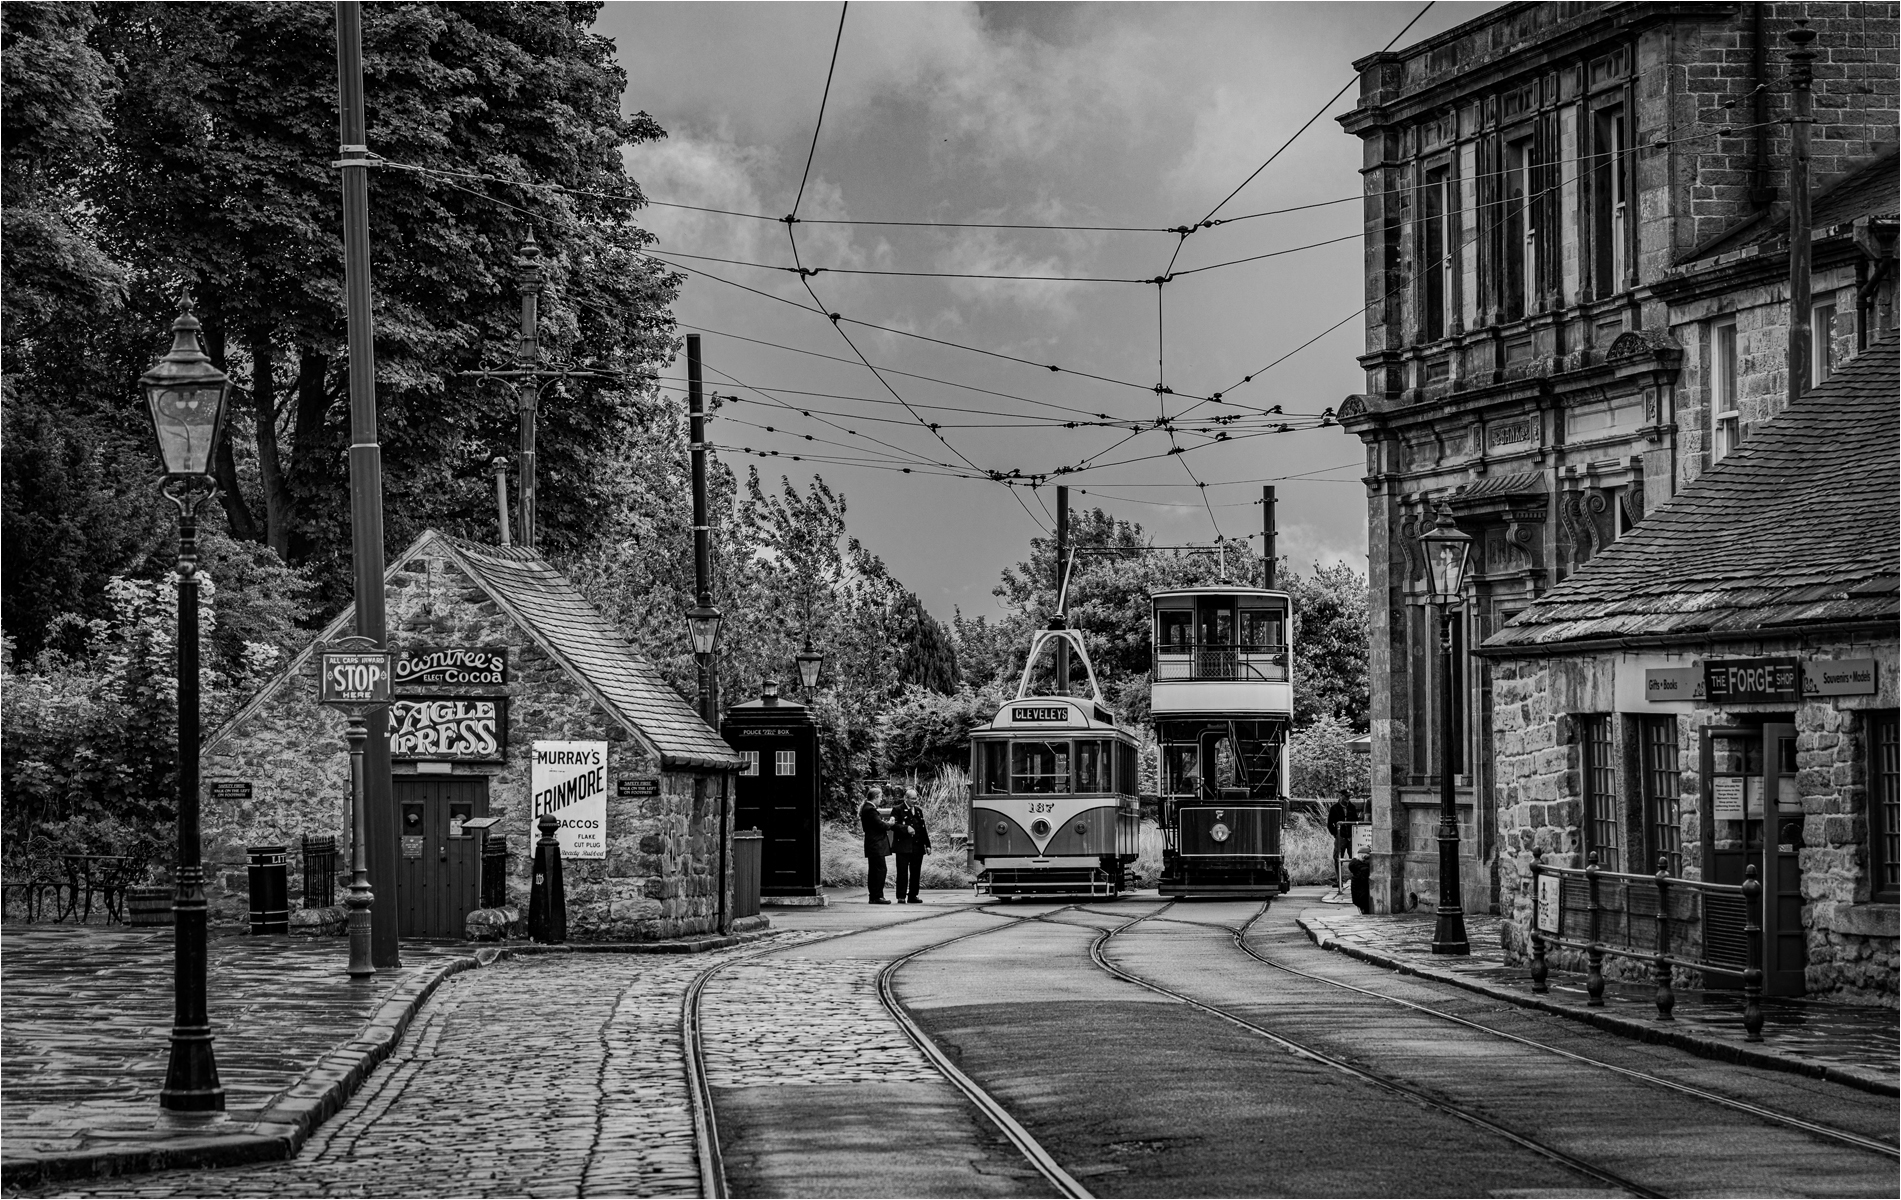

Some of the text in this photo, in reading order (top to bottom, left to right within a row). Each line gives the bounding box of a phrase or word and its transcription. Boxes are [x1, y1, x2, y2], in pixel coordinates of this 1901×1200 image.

[397, 649, 504, 675] owntree's
[333, 664, 380, 692] STOP
[423, 670, 503, 683] ELECT Cocoa
[1648, 679, 1678, 690] Gifts Books
[1711, 666, 1794, 694] THE FORGE SHOP
[1823, 670, 1871, 685] Souvenirs Models
[342, 691, 372, 699] HERE
[389, 700, 496, 736] AGLE
[1015, 708, 1068, 720] CLEVELEYS
[537, 749, 601, 766] MURRAY'S
[534, 765, 605, 820] ERINMORE
[556, 819, 600, 829] BACCOS
